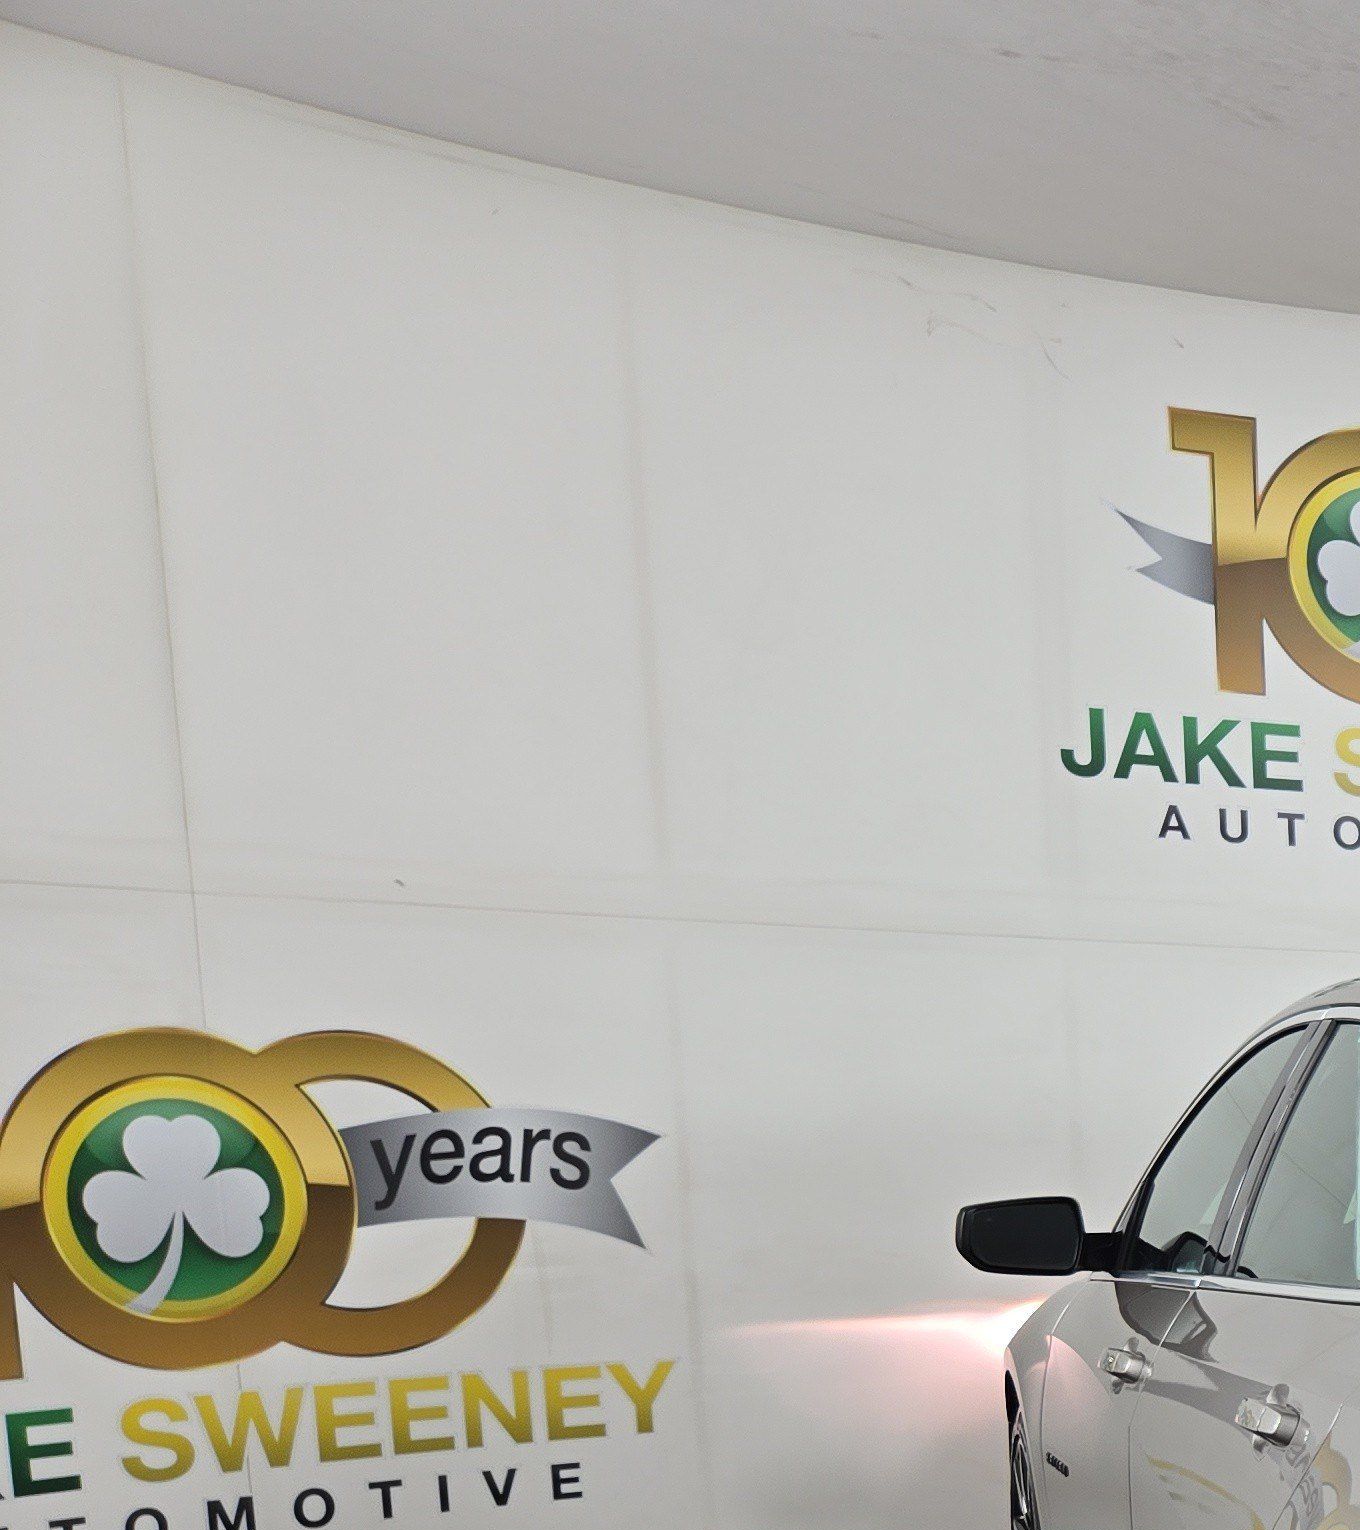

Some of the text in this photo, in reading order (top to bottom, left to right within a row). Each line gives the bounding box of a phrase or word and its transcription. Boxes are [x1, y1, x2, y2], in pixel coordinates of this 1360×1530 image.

[1060, 707, 1304, 793] JAKE
[0, 1026, 527, 1380] 00
[370, 1125, 592, 1211] years
[119, 1359, 675, 1483] SWEENEY
